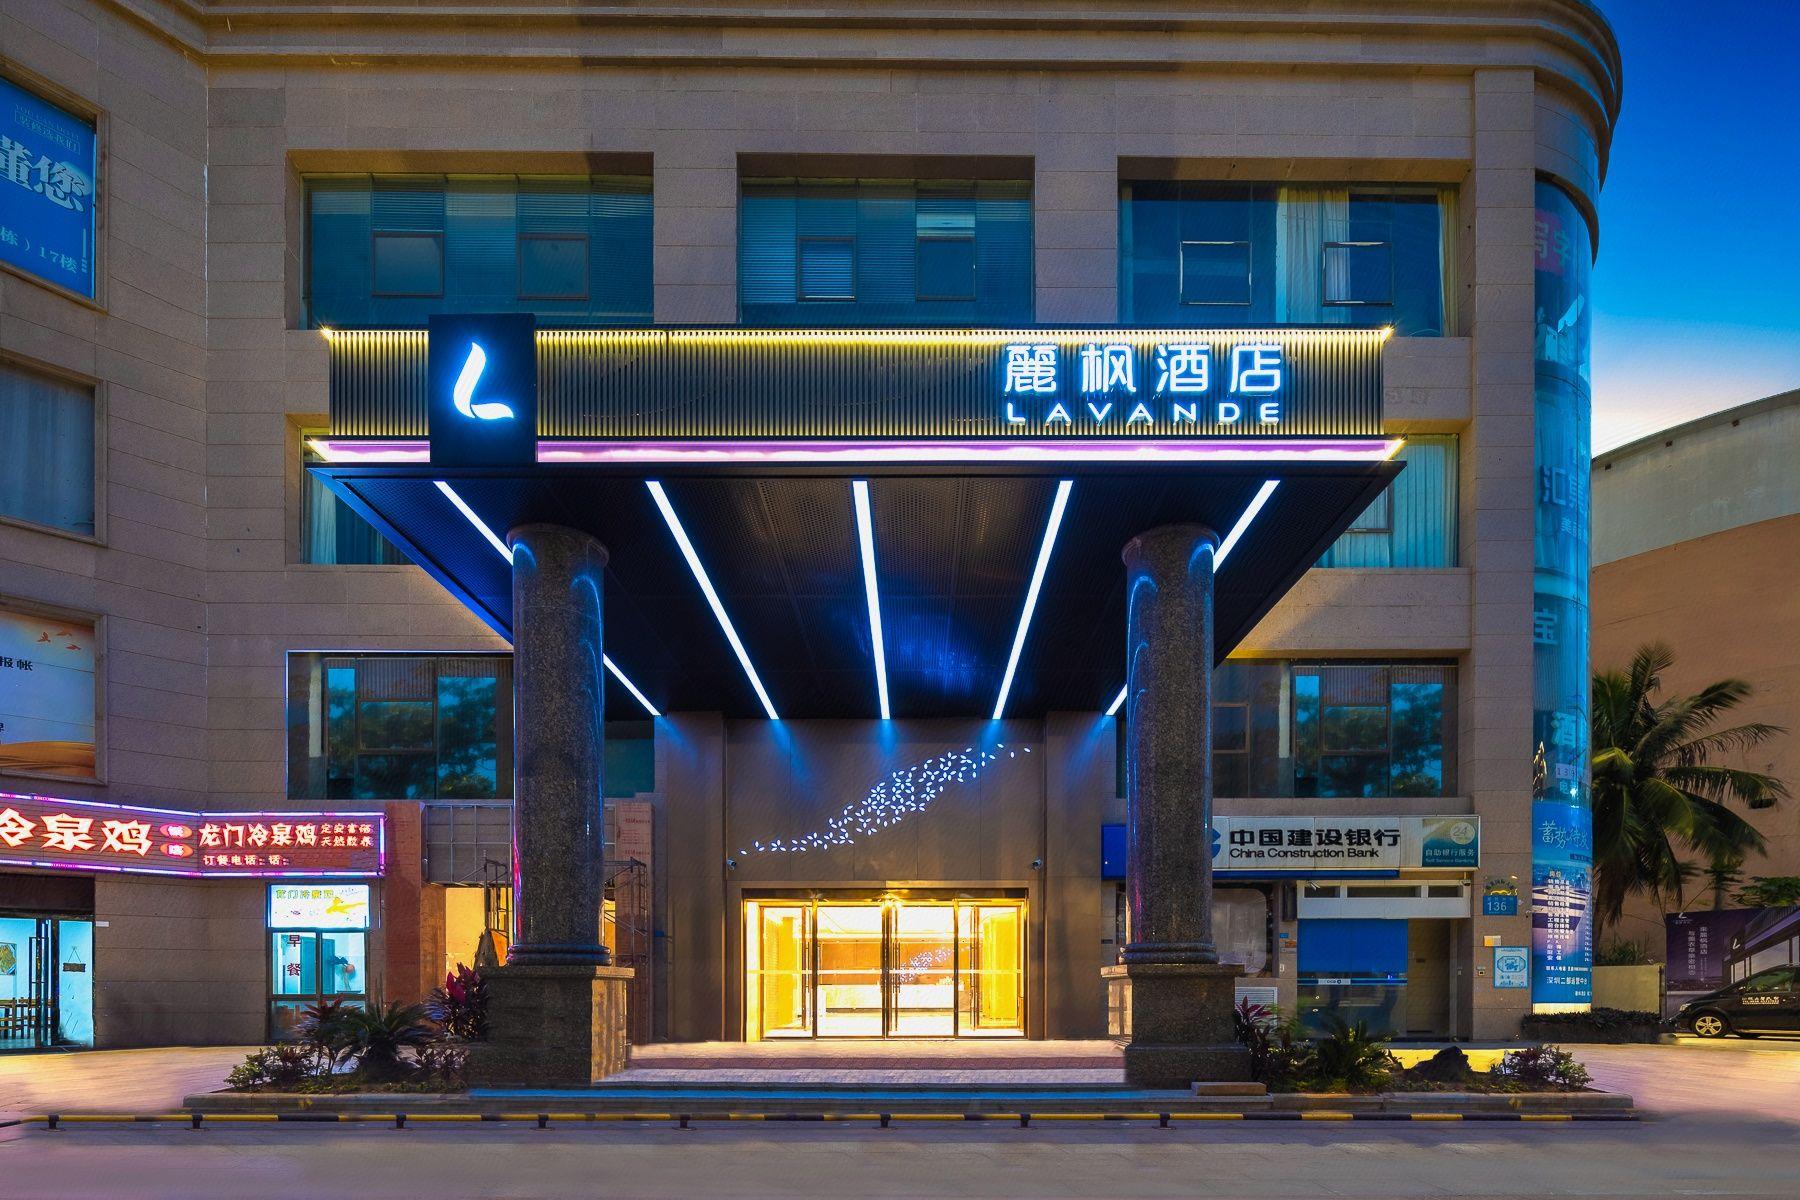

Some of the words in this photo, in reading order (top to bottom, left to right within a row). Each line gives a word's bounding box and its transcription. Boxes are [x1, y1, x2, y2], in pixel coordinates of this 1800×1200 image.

[1005, 344, 1282, 393] 麗枫酒店
[1006, 402, 1280, 424] LAVANDE
[199, 823, 317, 846] 龙门冷泉鸡
[1230, 829, 1400, 846] 中国建设银行
[1230, 848, 1265, 858] China
[1271, 848, 1344, 858] Construction
[1348, 848, 1379, 858] Bank
[1488, 901, 1507, 911] 136
